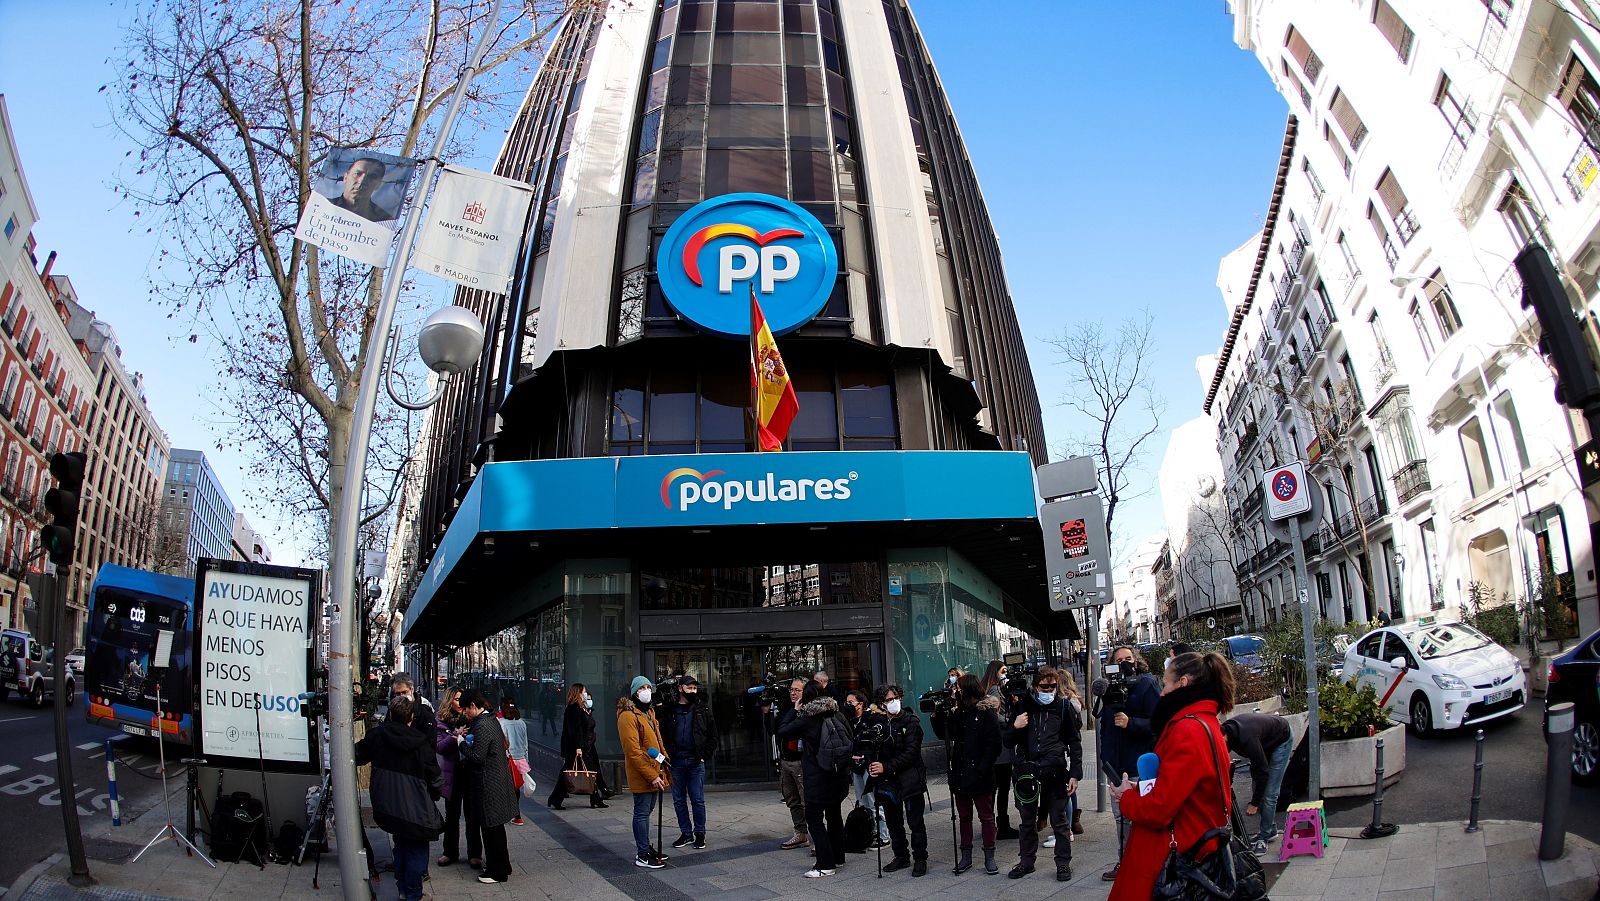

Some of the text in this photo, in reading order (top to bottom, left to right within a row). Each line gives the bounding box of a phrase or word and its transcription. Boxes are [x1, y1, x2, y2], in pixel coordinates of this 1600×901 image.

[309, 216, 378, 246] Un hombre
[330, 215, 361, 227] febrero
[438, 220, 499, 241] NAVES ESPAÑOL
[304, 228, 349, 251] de paso
[444, 268, 479, 283] MADRID
[680, 472, 851, 511] populares
[208, 581, 304, 607] AYUDAMOS
[158, 615, 170, 624] 704
[207, 608, 304, 633] A QUE HAYA
[206, 635, 265, 657] MENOS
[206, 662, 251, 682] PISOS
[206, 689, 300, 713] EN DESUSO
